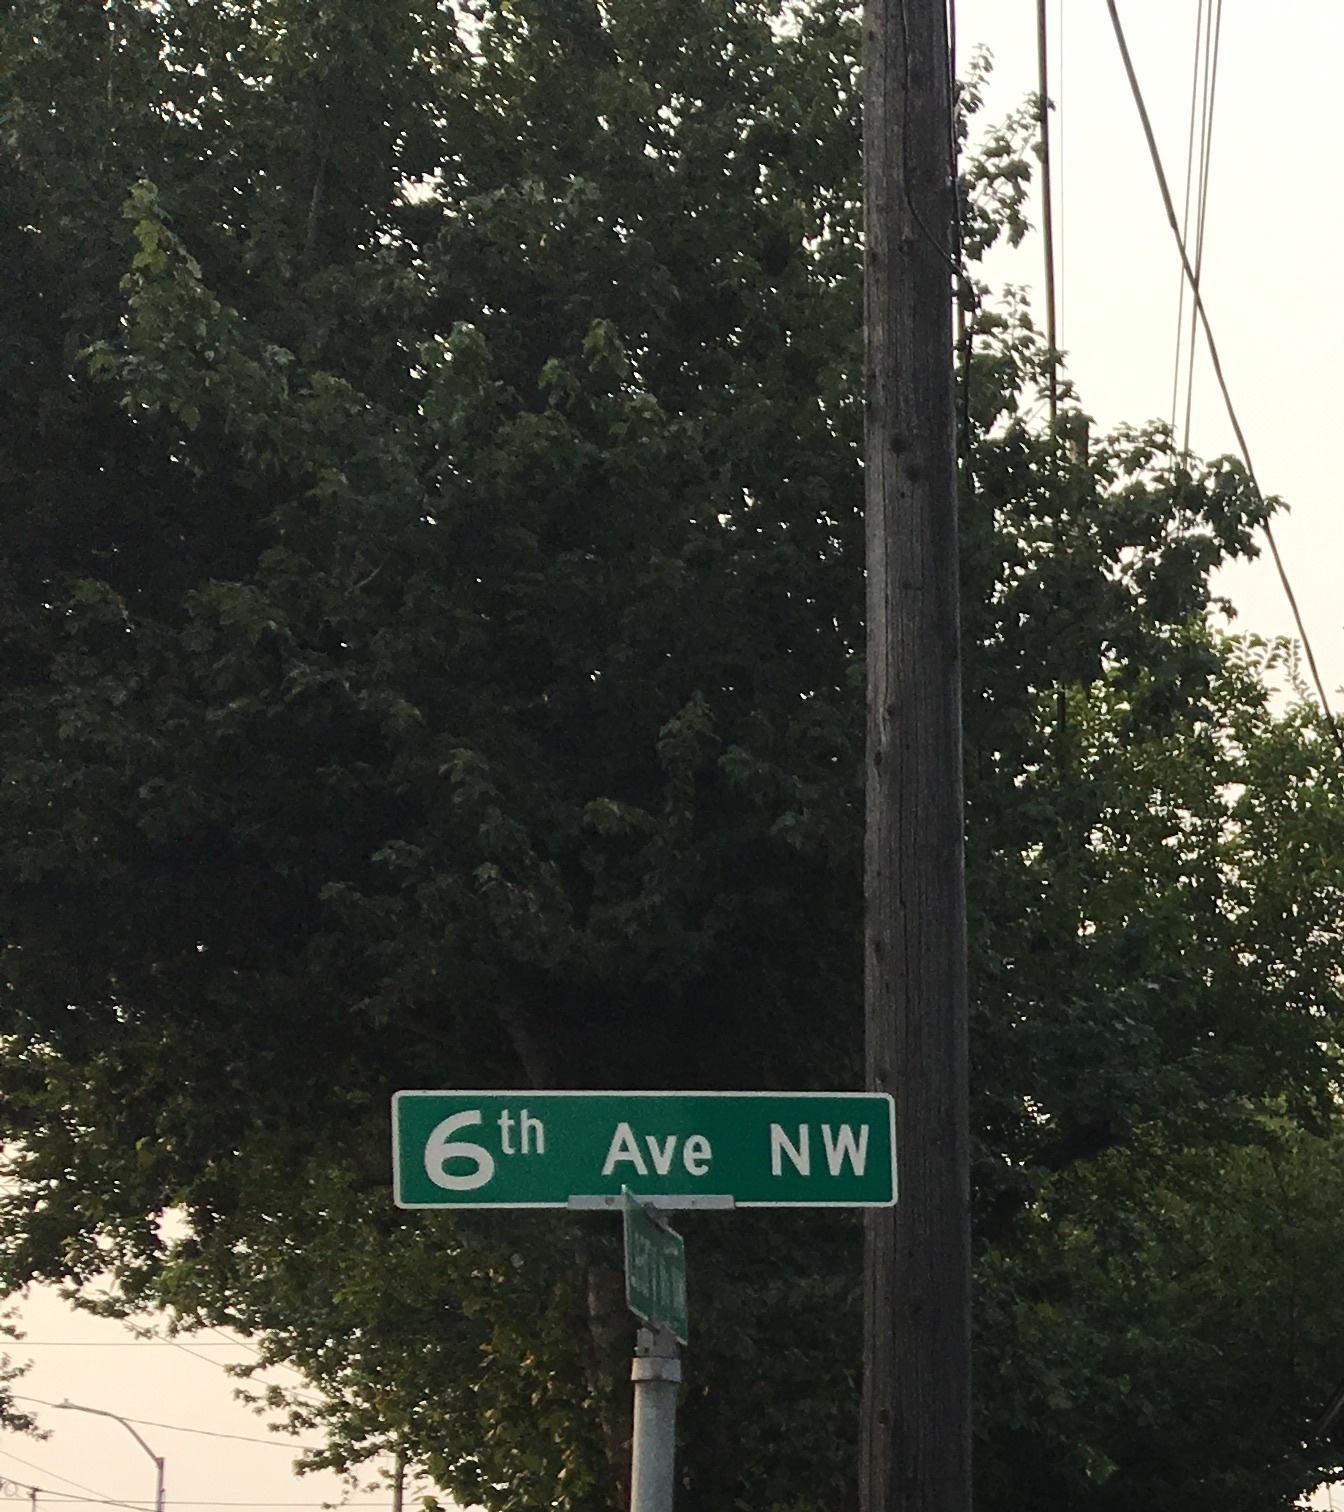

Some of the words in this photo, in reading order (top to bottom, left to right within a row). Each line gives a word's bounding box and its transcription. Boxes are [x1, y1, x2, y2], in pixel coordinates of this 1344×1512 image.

[423, 1108, 545, 1191] 6th
[601, 1121, 713, 1176] Ave
[770, 1122, 870, 1177] NW
